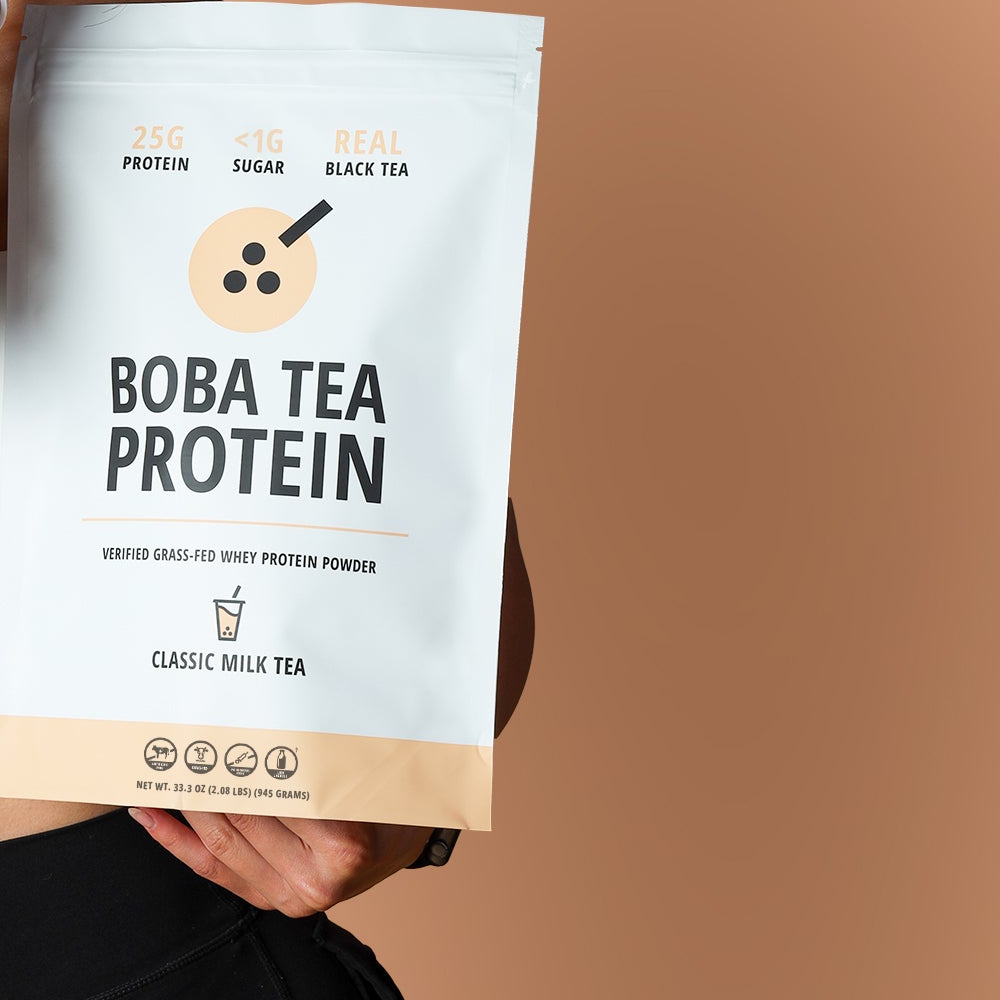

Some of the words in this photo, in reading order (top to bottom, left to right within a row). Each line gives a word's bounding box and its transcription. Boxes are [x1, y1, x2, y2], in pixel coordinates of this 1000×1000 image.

[131, 125, 185, 150] 25G
[234, 128, 284, 154] <1G
[334, 129, 403, 155] REAL
[122, 155, 190, 172] PROTEIN
[232, 158, 285, 175] SUGAR
[325, 161, 375, 177] BLACK
[380, 162, 410, 178] TEA
[110, 355, 259, 416] BOBA
[281, 360, 387, 424] TEA
[106, 425, 387, 505] PROTEIN
[102, 547, 150, 561] VERIFIED
[153, 547, 216, 563] GRASS-FED
[220, 550, 258, 565] WHEY
[261, 552, 318, 569] PROTEIN
[322, 556, 377, 575] POWDER
[151, 650, 215, 671] CLASSIC
[221, 653, 268, 675] MILK
[273, 656, 306, 677] TEA
[136, 780, 152, 790] NET
[155, 782, 171, 792] WT.
[173, 783, 192, 793] 33.3
[194, 785, 206, 794] OZ
[208, 785, 230, 796] (2.08
[232, 787, 252, 798] LBS)
[254, 788, 273, 799] (945
[275, 789, 310, 801] GRAMS)
